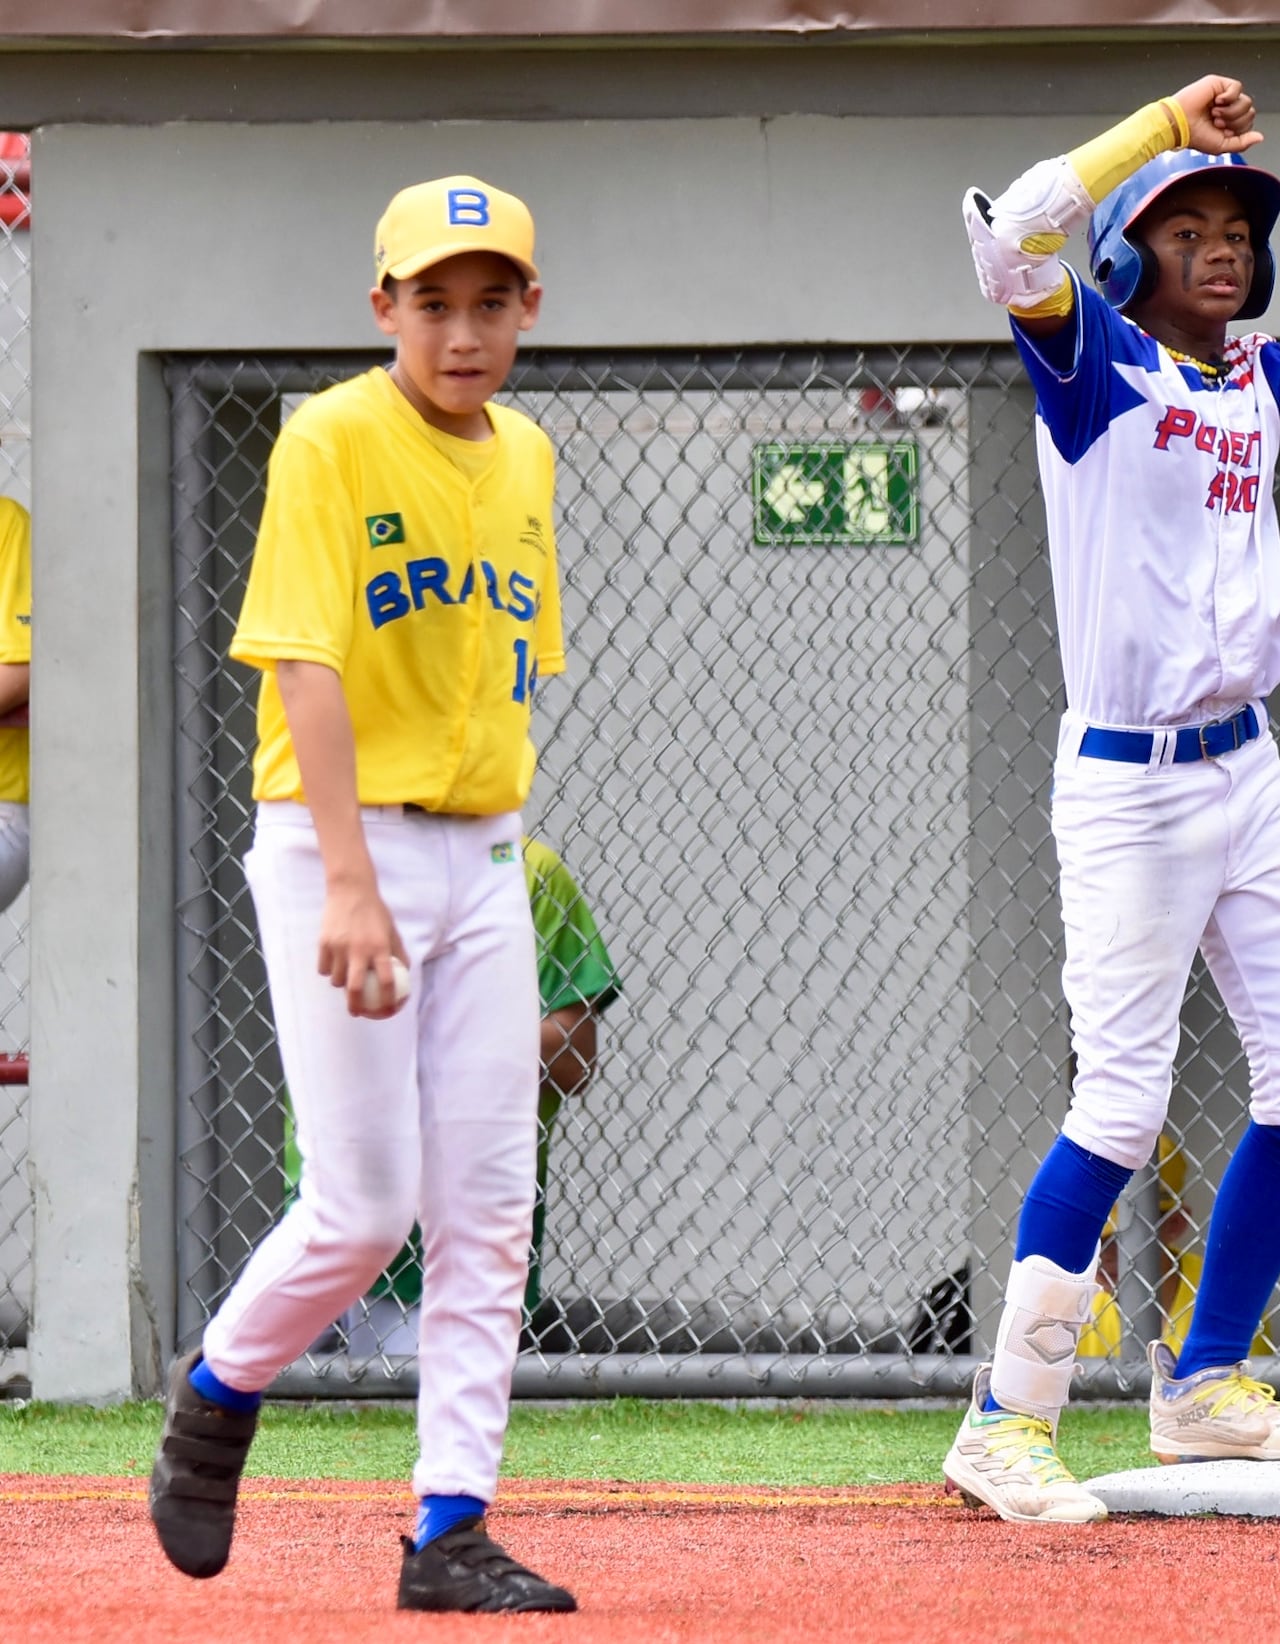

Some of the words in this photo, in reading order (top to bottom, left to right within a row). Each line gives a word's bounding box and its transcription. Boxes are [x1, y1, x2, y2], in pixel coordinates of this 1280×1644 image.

[447, 188, 491, 227] B
[365, 556, 541, 631] BRAS
[511, 637, 539, 705] 1
